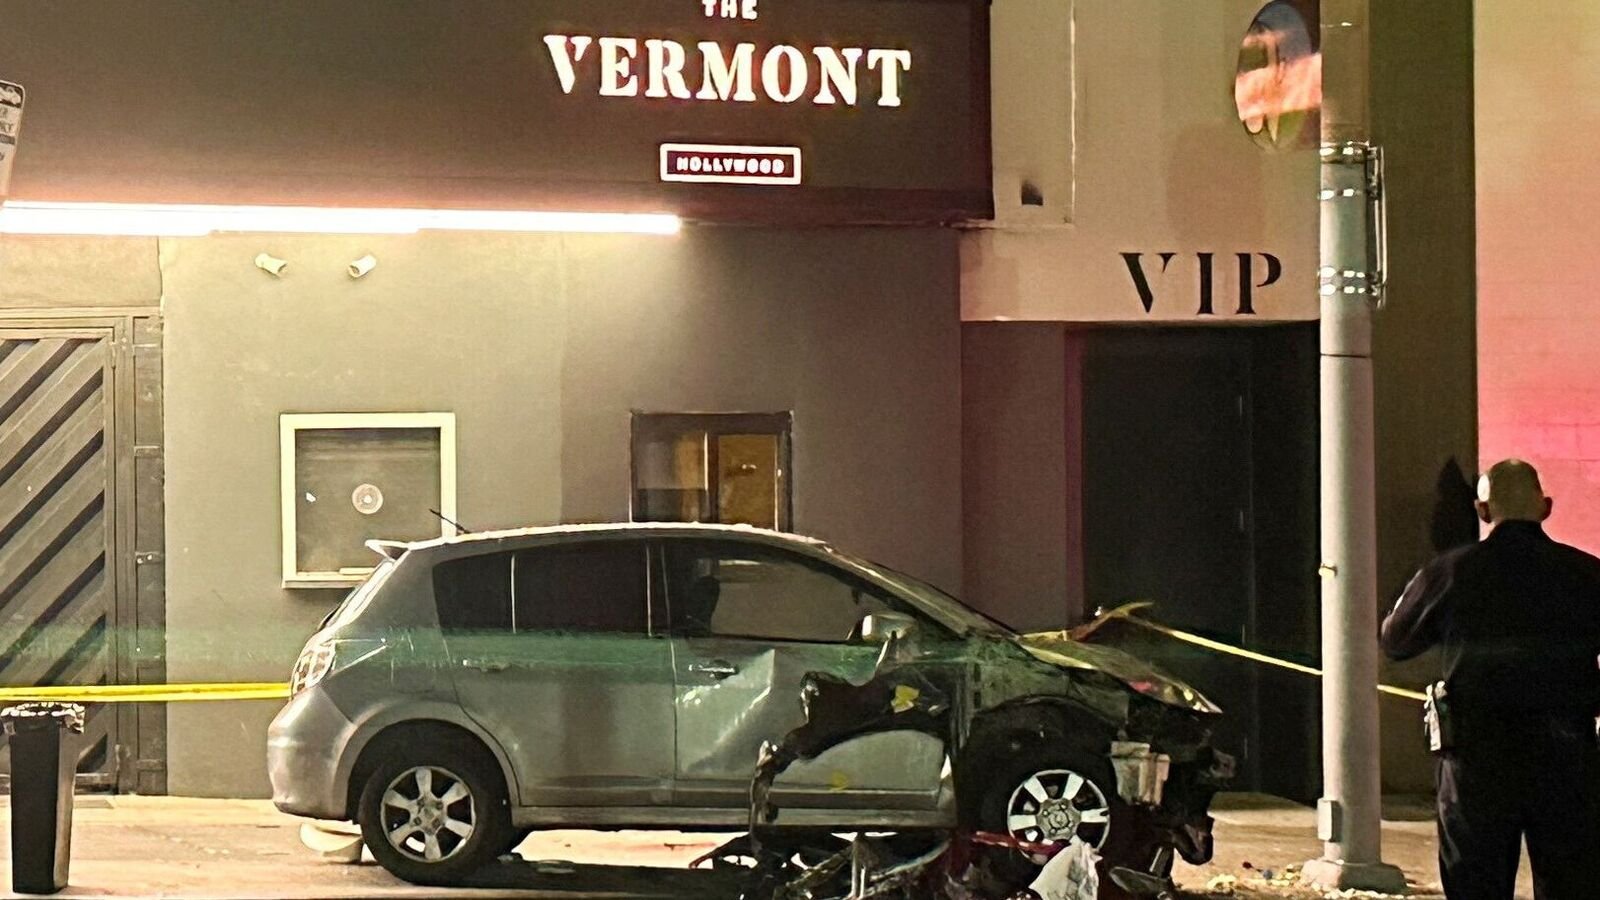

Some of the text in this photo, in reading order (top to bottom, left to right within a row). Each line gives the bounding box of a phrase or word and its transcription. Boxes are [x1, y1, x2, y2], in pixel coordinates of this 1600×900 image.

[701, 0, 758, 20] THE
[543, 34, 912, 107] VERMONT
[676, 156, 785, 174] HOLLYWOOD
[1118, 251, 1282, 315] VIP
